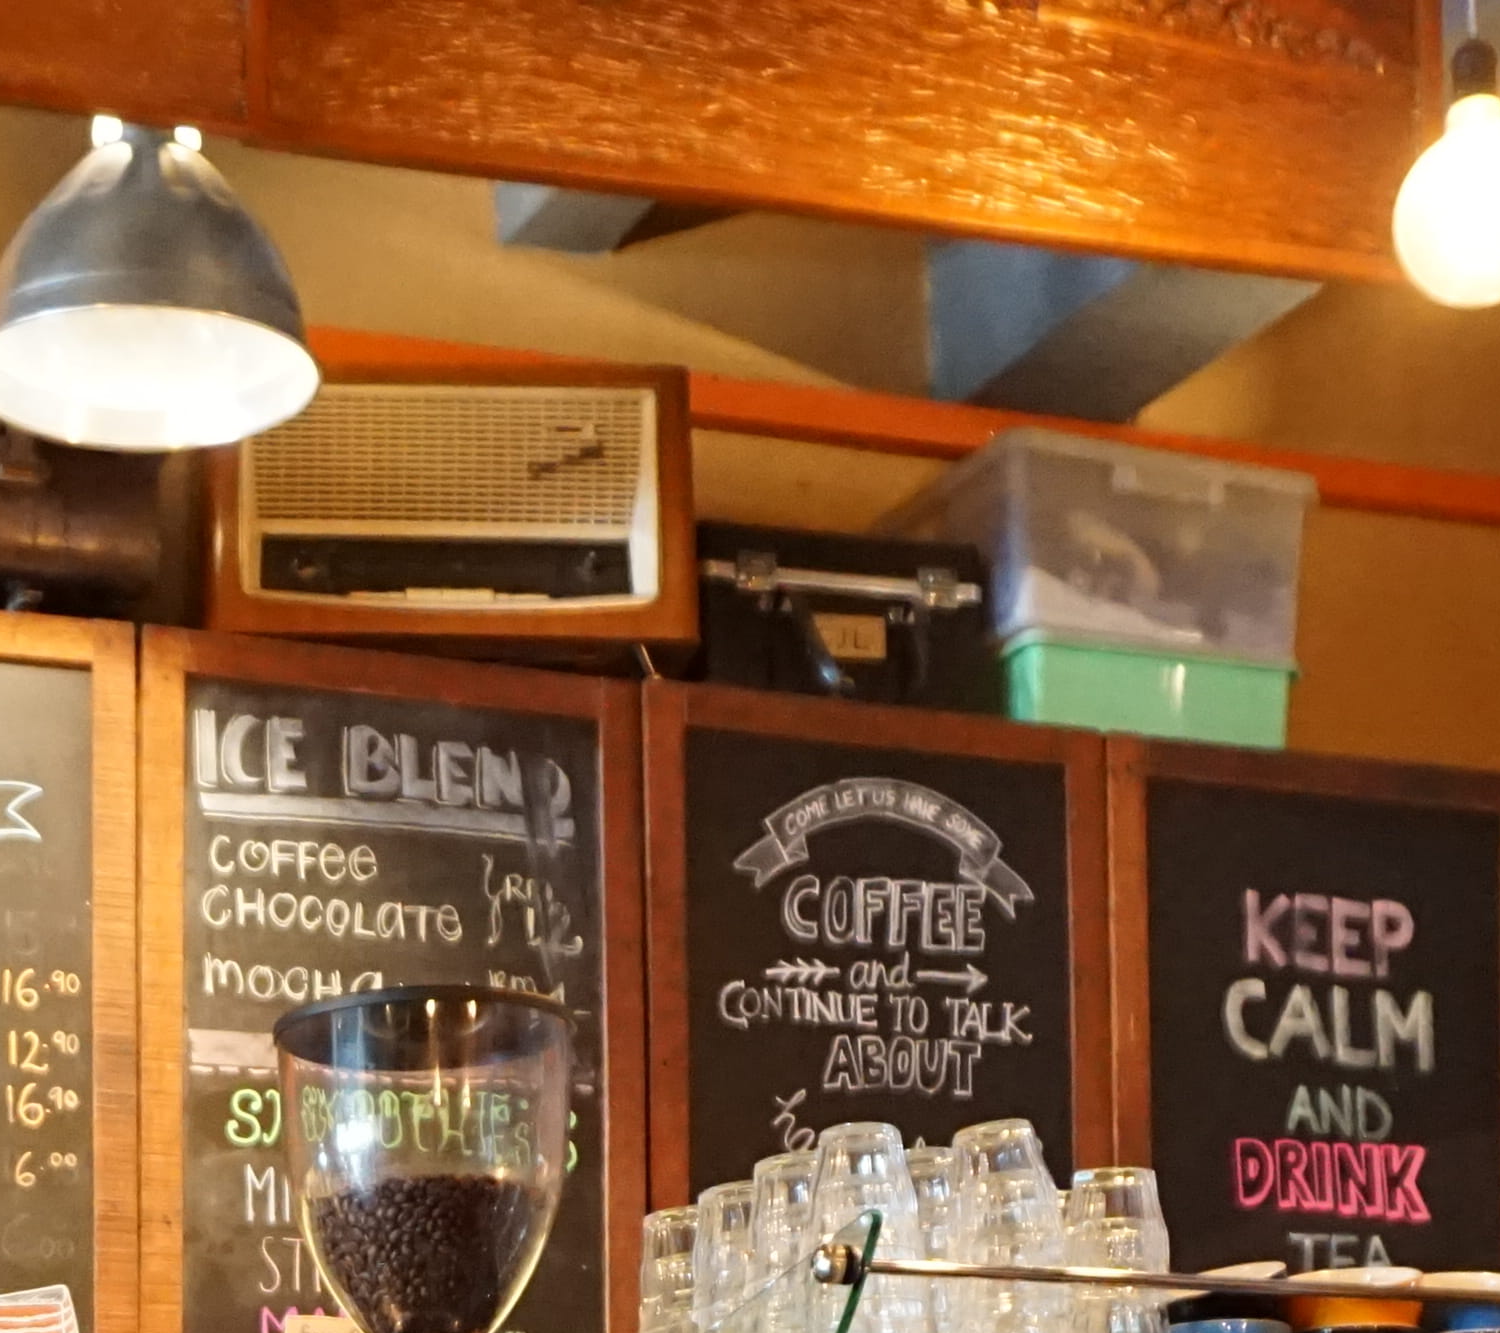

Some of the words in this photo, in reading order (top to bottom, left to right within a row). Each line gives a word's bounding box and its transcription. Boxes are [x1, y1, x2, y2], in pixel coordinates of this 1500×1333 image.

[194, 708, 307, 793] ICE
[343, 724, 574, 818] BLEND
[784, 799, 830, 836] COME
[834, 788, 867, 813] LET
[869, 788, 895, 808] US
[782, 874, 987, 952] COFFEE
[1244, 888, 1416, 979] KEEP
[1, 967, 81, 1009] 16.90
[850, 951, 914, 992] and
[718, 980, 879, 1030] CONTINUE
[889, 992, 930, 1034] TO
[945, 996, 1033, 1046] TALK
[1222, 977, 1437, 1072] CALM
[6, 1030, 80, 1074] 12.90
[822, 1034, 983, 1097] ABOUT
[5, 1082, 79, 1129] 16.90
[1285, 1084, 1394, 1141] AND
[1233, 1136, 1433, 1224] DRINK
[1284, 1231, 1394, 1273] TEA
